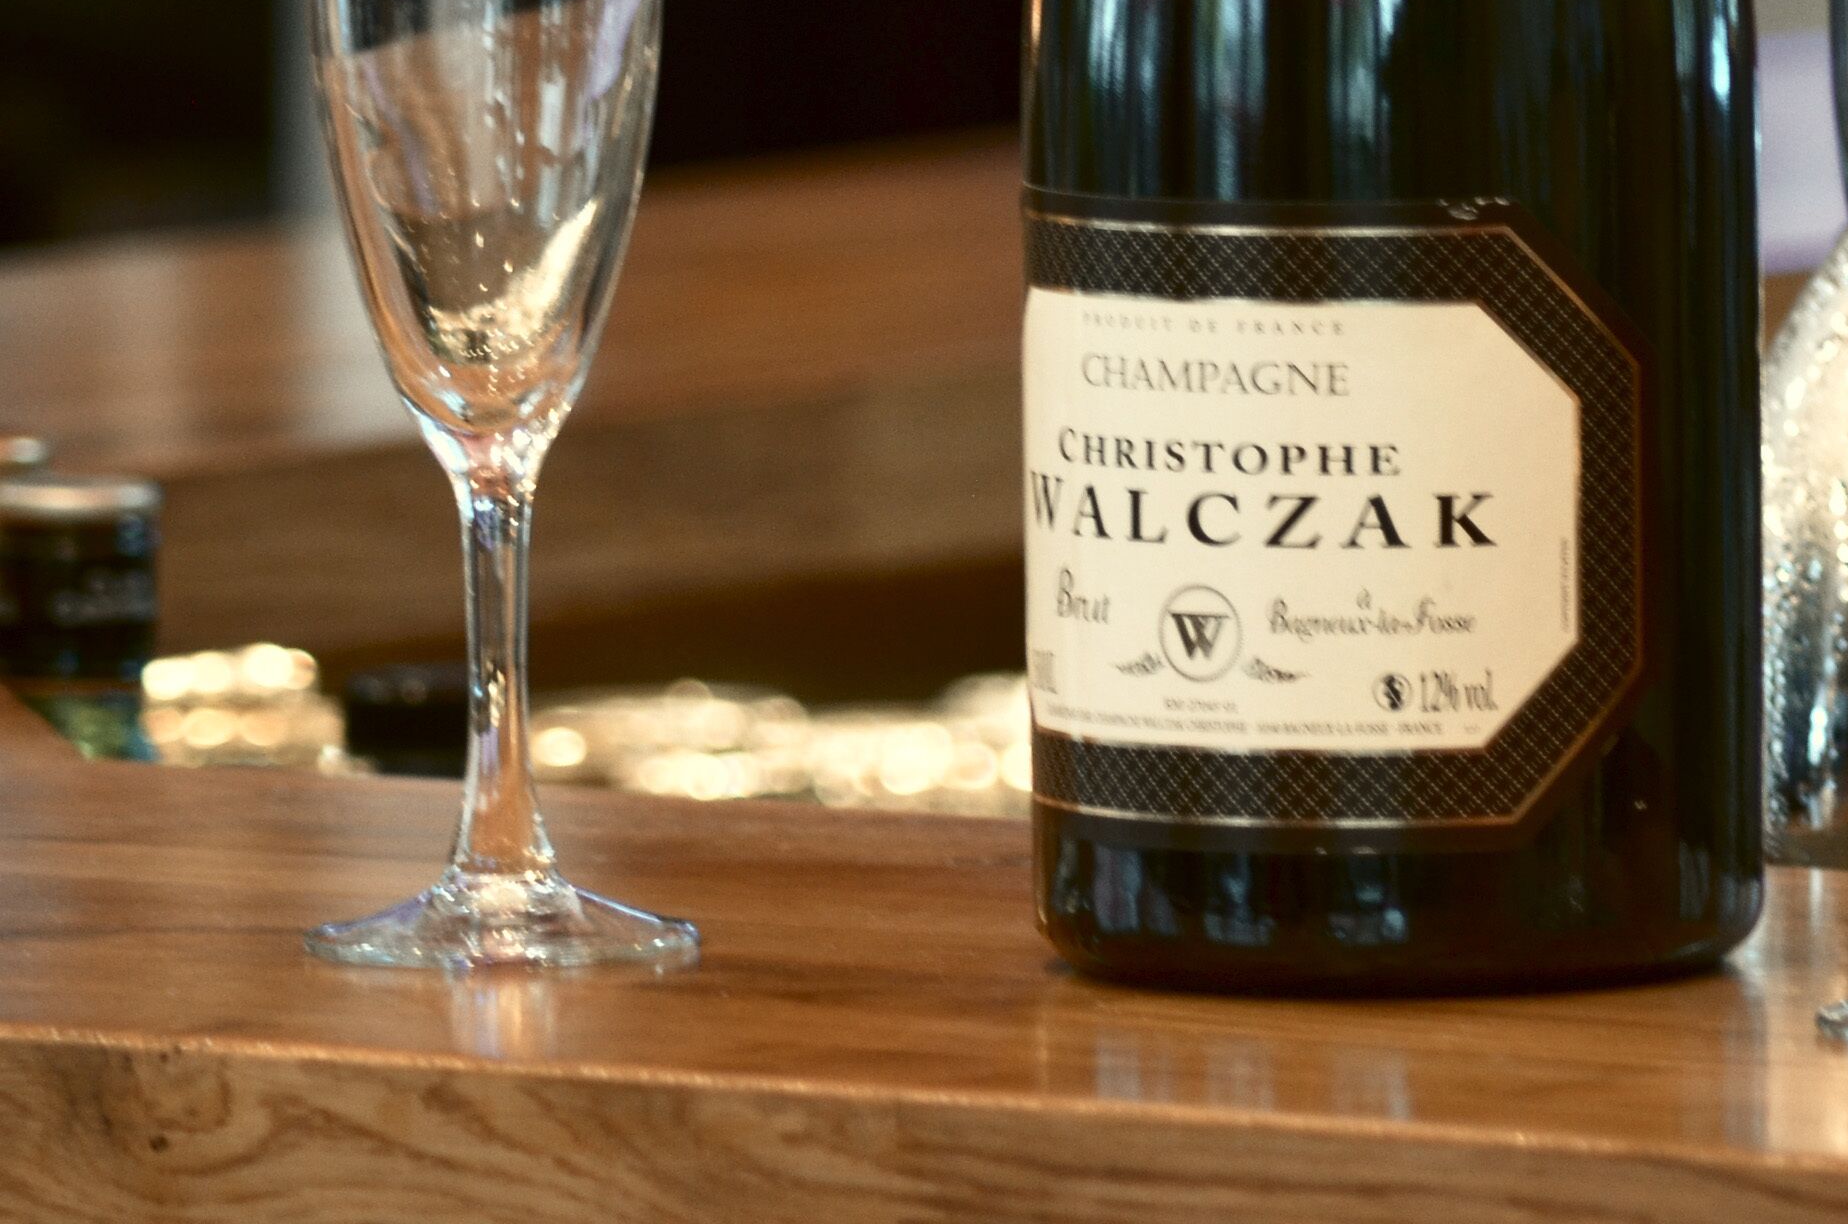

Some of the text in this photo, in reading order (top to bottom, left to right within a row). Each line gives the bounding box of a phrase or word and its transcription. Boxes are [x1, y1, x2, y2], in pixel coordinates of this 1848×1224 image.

[1082, 310, 1344, 336] PRODUIT DE FRANCE
[1081, 352, 1349, 396] CHAMPAGNE
[1058, 426, 1400, 477] CHRISTOPHE
[1031, 472, 1498, 550] WALCZAK
[1056, 567, 1110, 624] Brut
